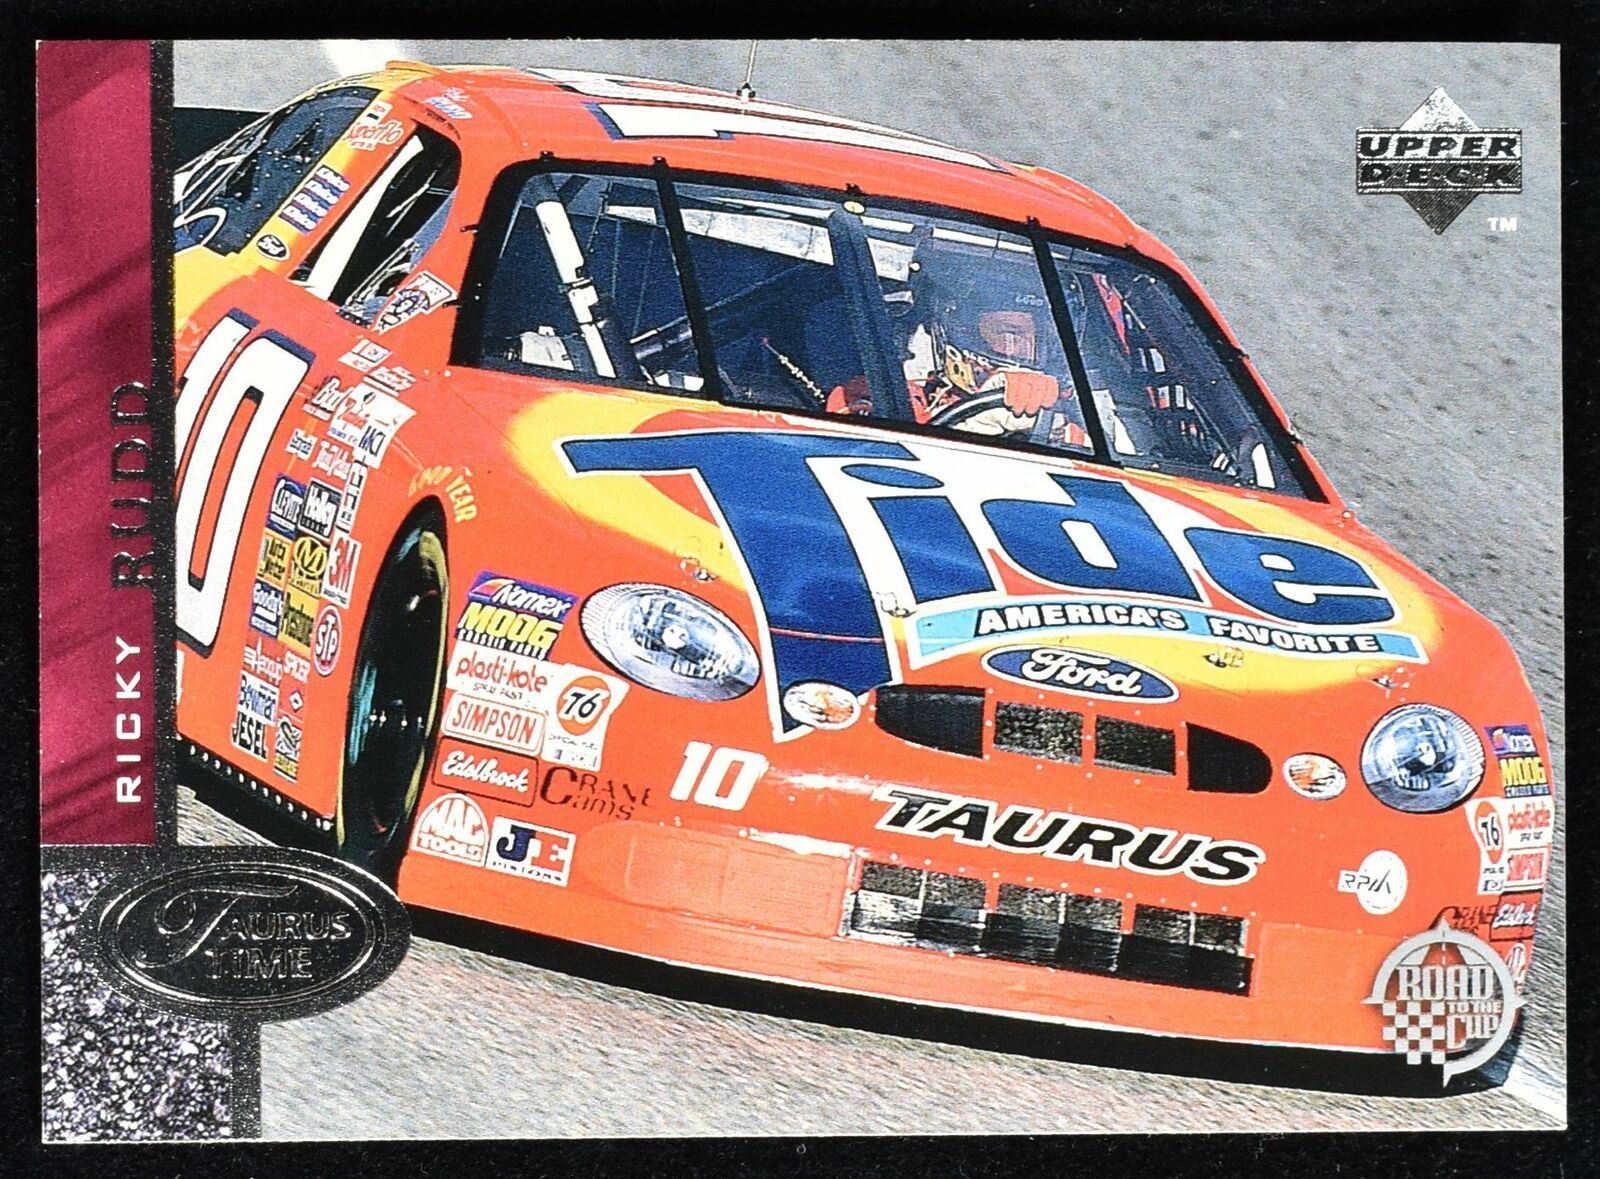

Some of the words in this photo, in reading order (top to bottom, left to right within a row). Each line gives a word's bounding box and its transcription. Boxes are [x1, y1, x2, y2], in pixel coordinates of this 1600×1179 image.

[1358, 135, 1519, 158] UPPER
[1487, 216, 1518, 232] TM
[109, 379, 155, 590] RUDD
[490, 584, 572, 618] Nomex
[561, 430, 1396, 735] Tide
[315, 612, 341, 662] STP
[460, 601, 564, 650] MOOG
[974, 603, 1189, 638] AMERICA'S
[1205, 616, 1383, 653] FAVORITE
[455, 650, 548, 693] plasti-kote
[1022, 647, 1144, 697] Ford
[115, 635, 142, 804] RICKY
[452, 700, 538, 745] SIMPSON
[564, 691, 602, 719] 76
[231, 710, 268, 761] JESEL
[441, 750, 530, 793] Edelbrock
[669, 740, 769, 812] 10
[1500, 757, 1548, 786] MOOG
[496, 824, 570, 873] JE
[889, 788, 1261, 884] TAURUS
[1480, 815, 1501, 847] 76
[204, 946, 314, 980] TIME
[1395, 964, 1494, 1001] ROAD
[1446, 1014, 1500, 1050] CUP
